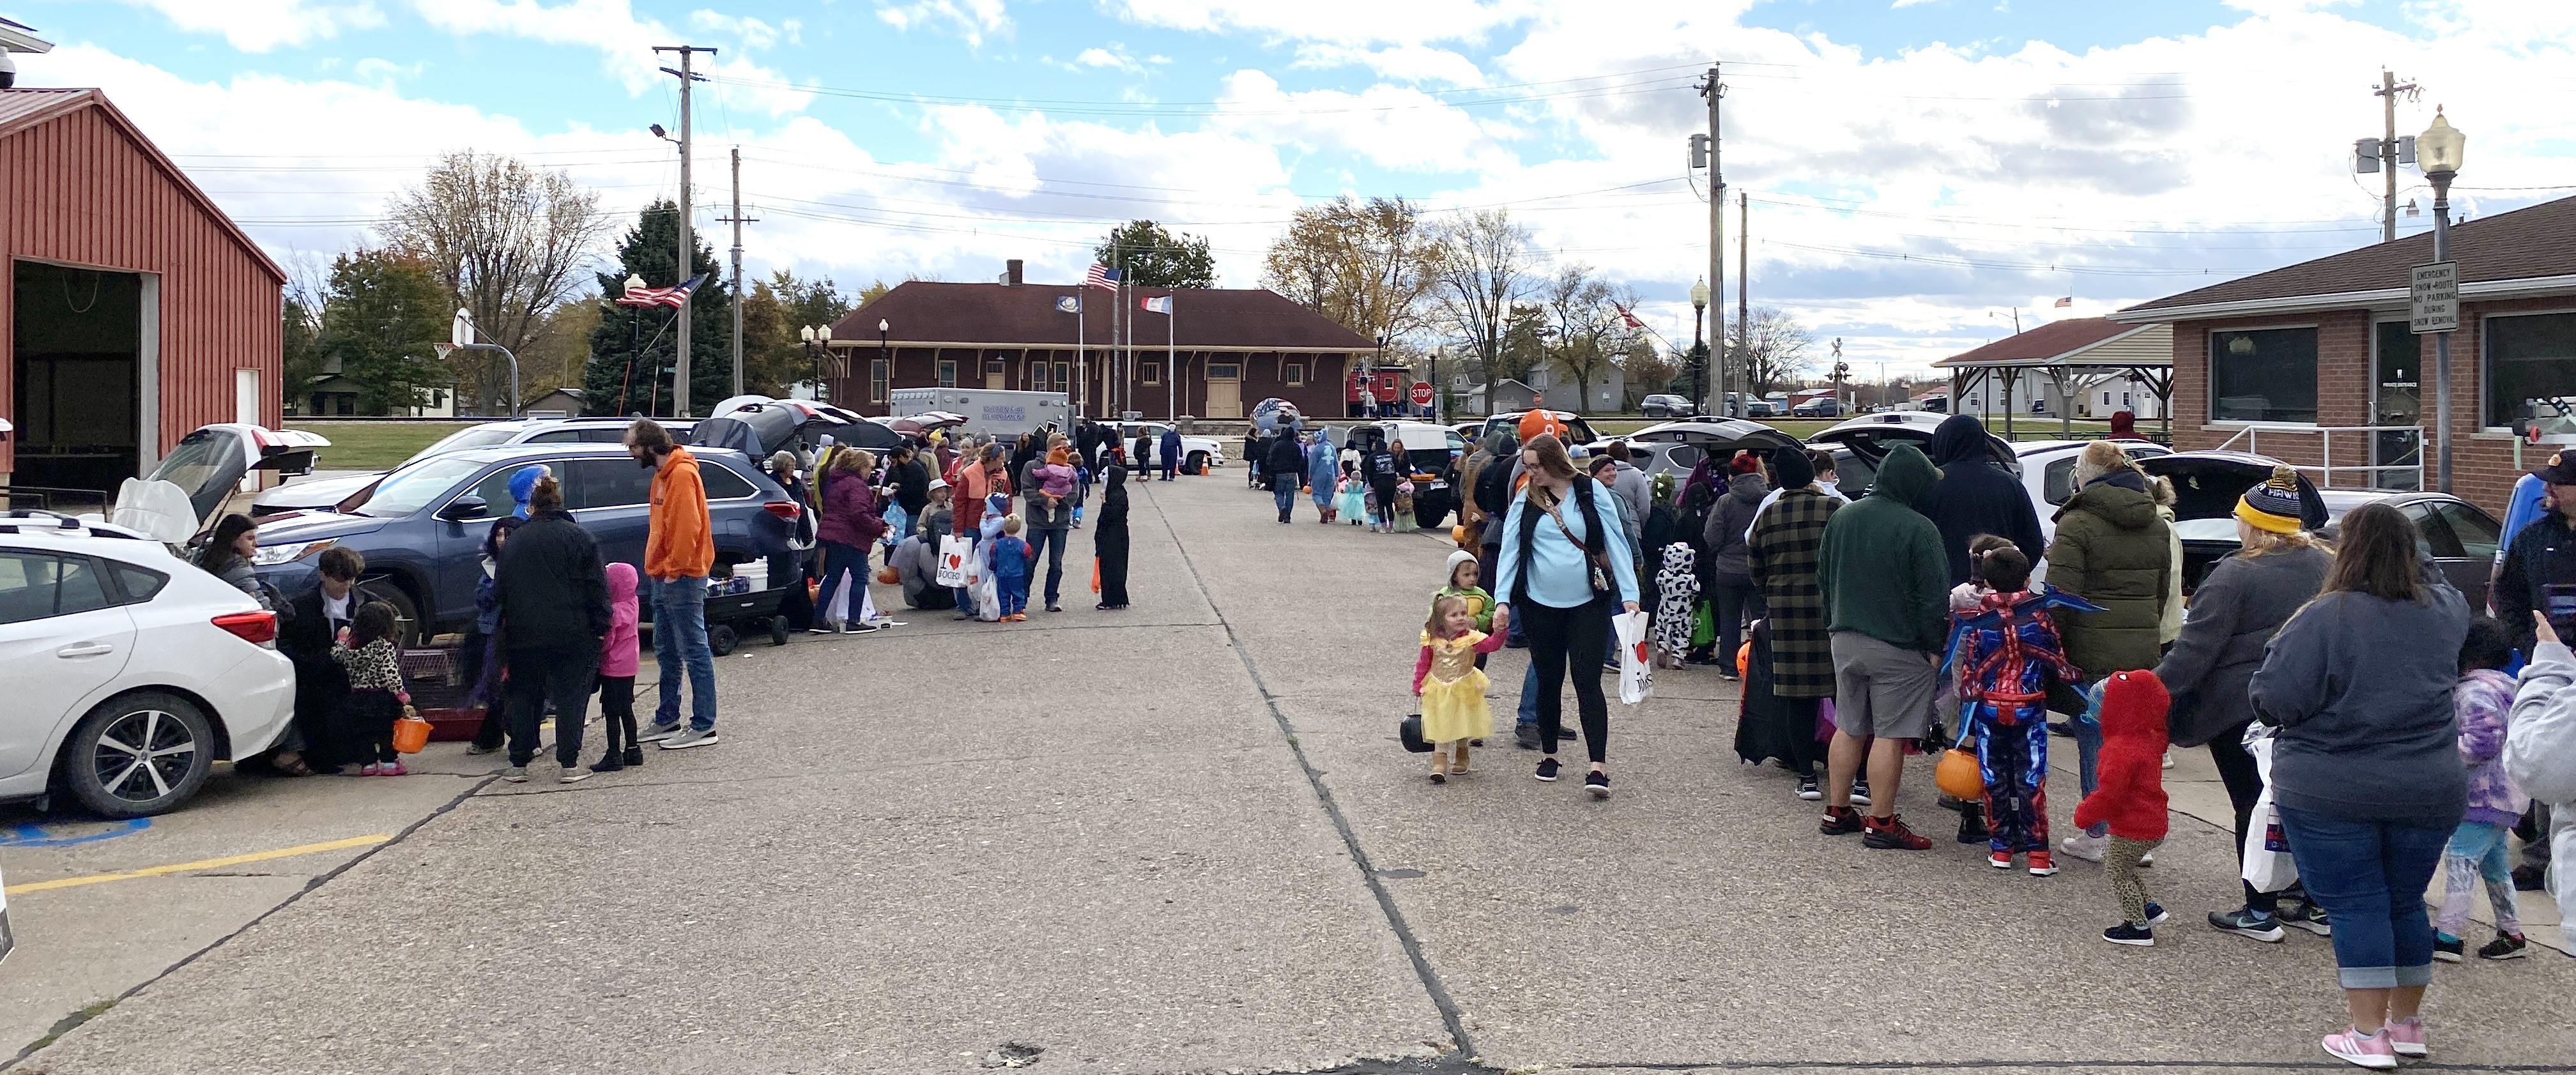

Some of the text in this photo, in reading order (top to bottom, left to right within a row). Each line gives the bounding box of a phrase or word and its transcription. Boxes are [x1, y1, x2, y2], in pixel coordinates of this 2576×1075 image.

[2417, 268, 2450, 280] EMERGENCY
[2415, 280, 2453, 291] SNOW ROUTE
[2414, 292, 2456, 303] NO PARKING
[2424, 305, 2445, 314] DURING
[2414, 316, 2456, 326] SNOW REMOVAL
[1412, 388, 1431, 397] STOP
[940, 553, 949, 569] I
